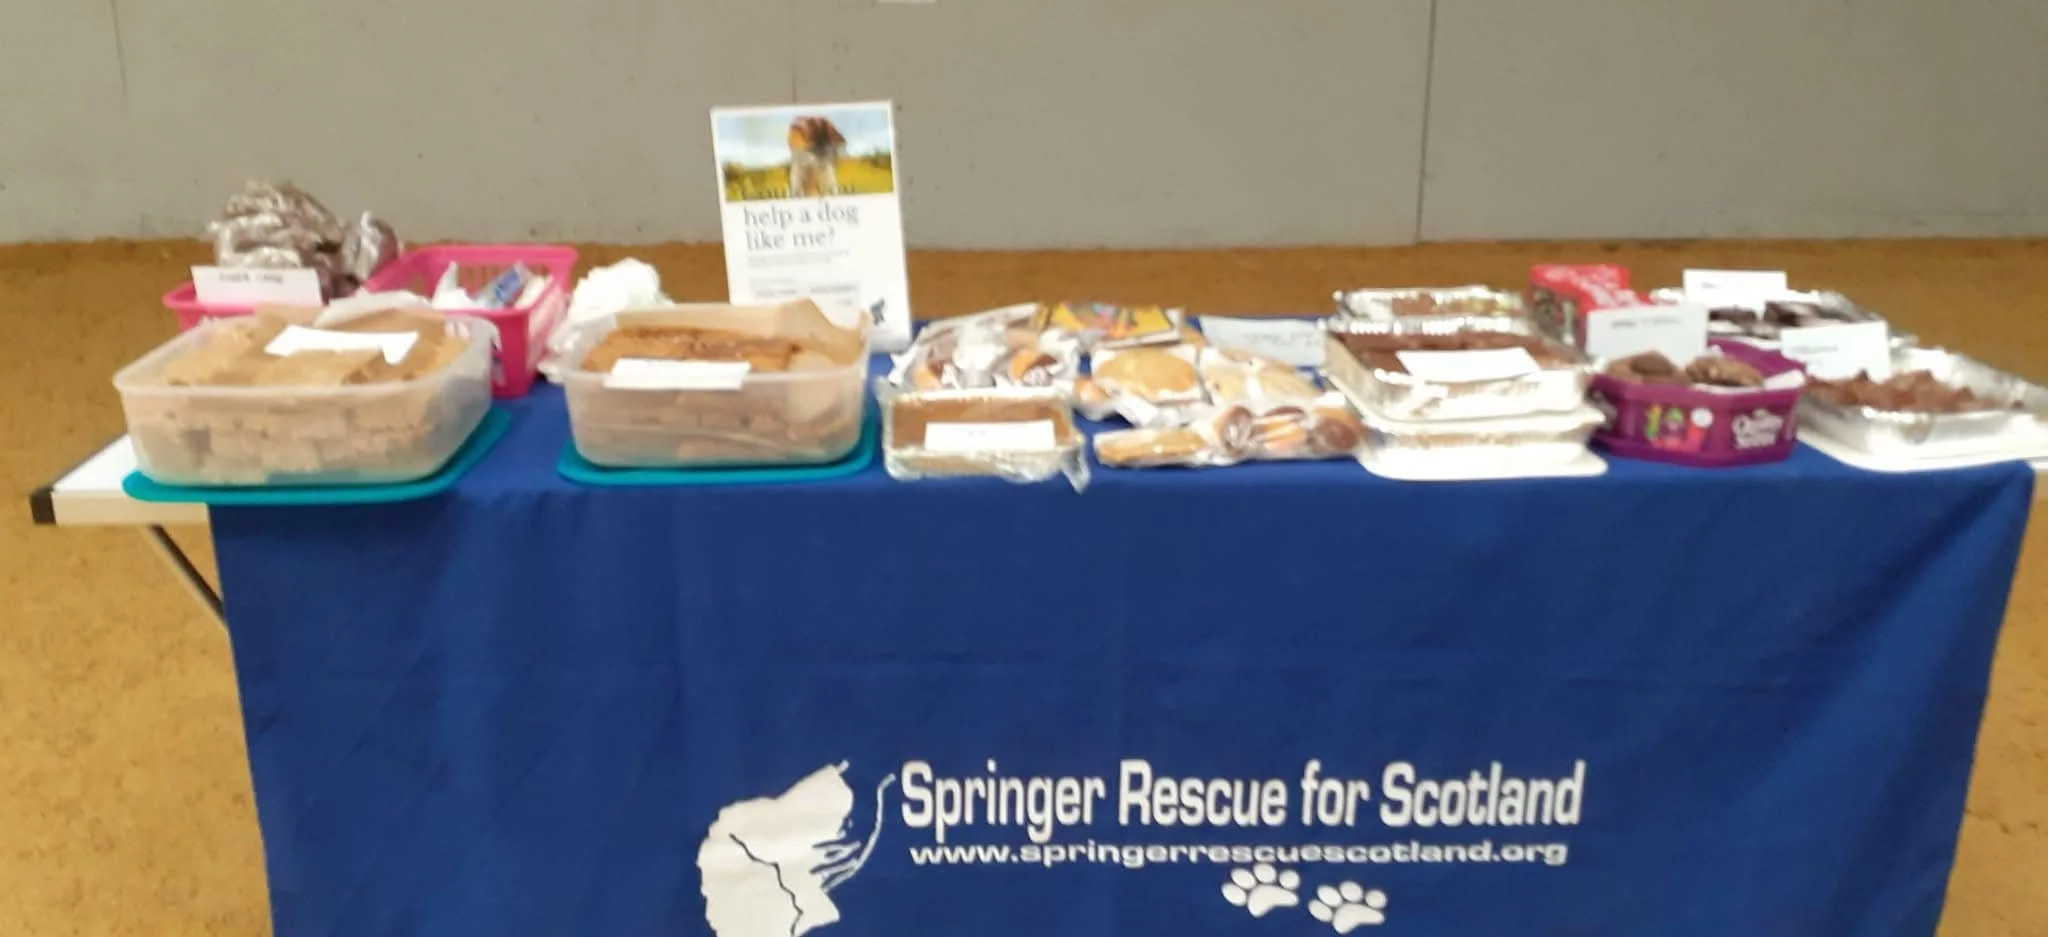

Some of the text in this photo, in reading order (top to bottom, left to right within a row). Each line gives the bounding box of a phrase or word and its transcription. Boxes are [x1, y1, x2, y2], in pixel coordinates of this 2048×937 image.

[743, 202, 860, 231] help a dog
[745, 225, 836, 251] like me?
[901, 758, 1588, 844] Springer Rescue for Scotland
[909, 839, 1568, 869] www.springerrescuescotland.org
